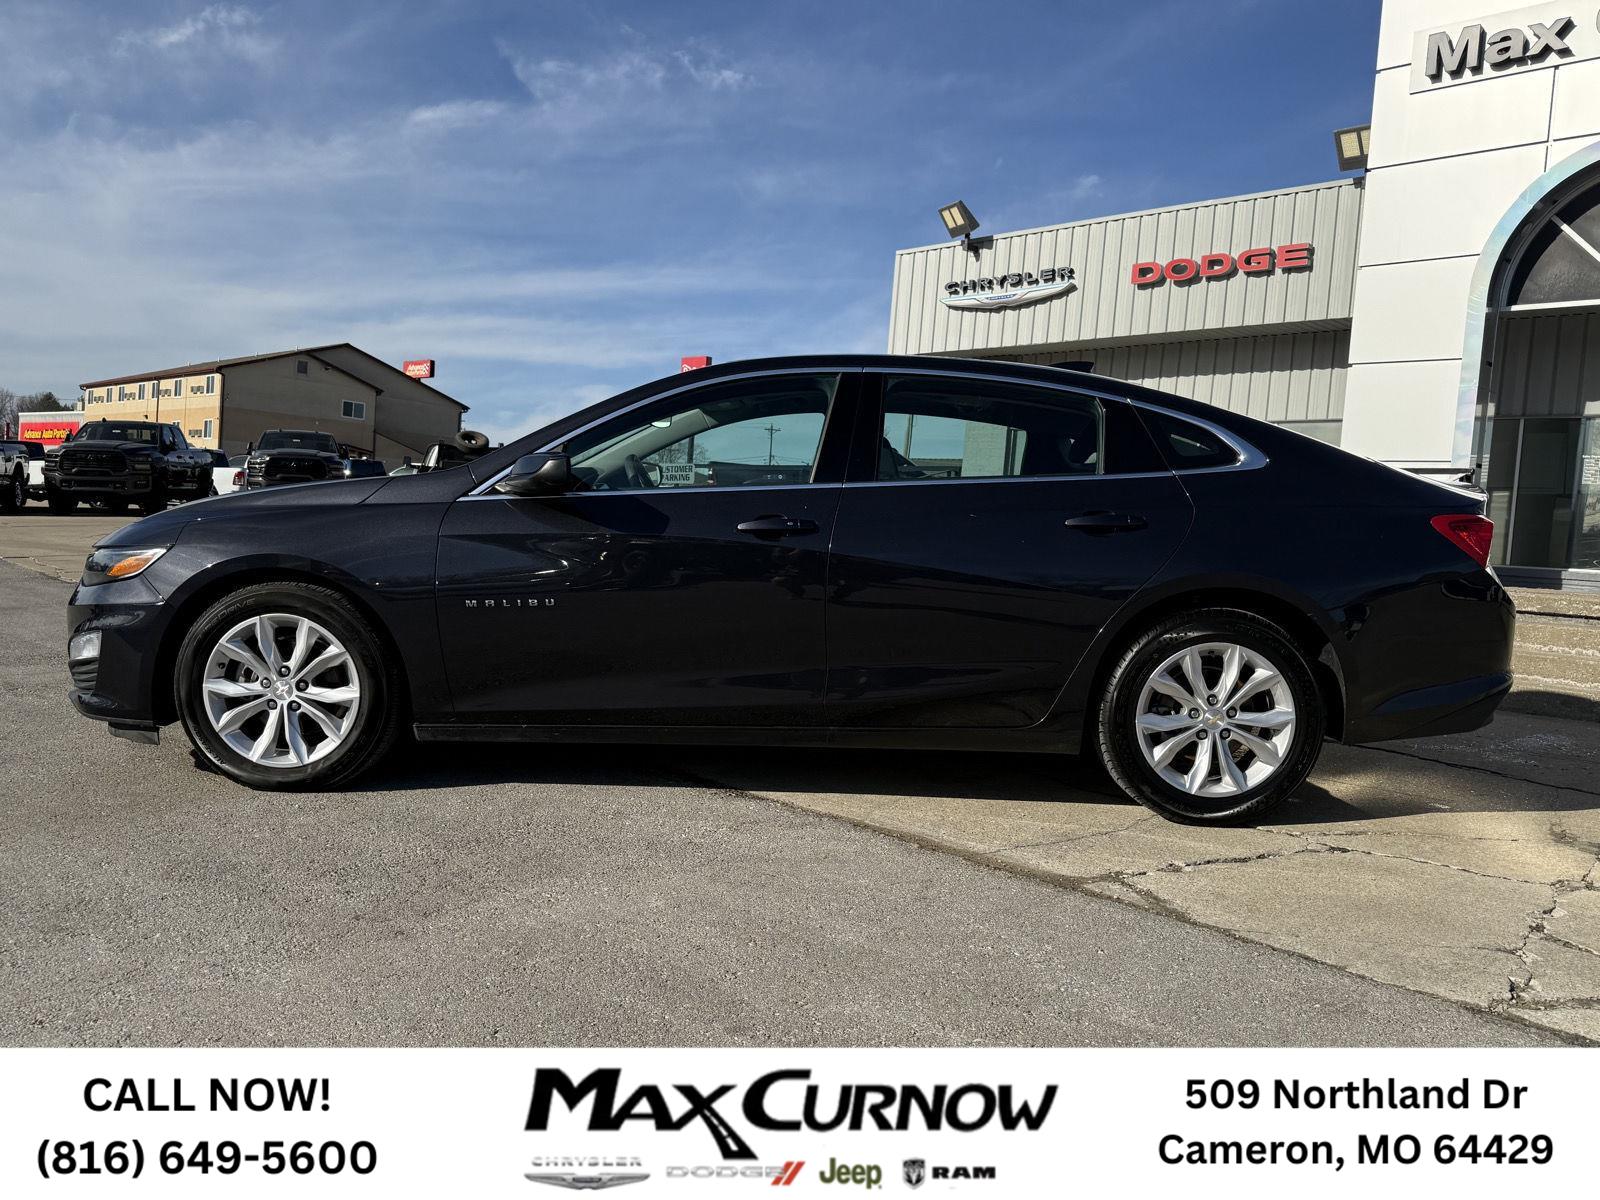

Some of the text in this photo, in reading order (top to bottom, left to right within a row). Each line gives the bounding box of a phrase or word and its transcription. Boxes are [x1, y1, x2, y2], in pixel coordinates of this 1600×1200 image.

[1425, 16, 1575, 82] Max
[1131, 243, 1313, 289] DODGE
[945, 267, 1074, 294] CHRYSLER
[42, 429, 54, 439] Auto
[662, 465, 693, 473] USTOMER
[662, 474, 690, 482] ARKING
[465, 598, 555, 607] MALIBU
